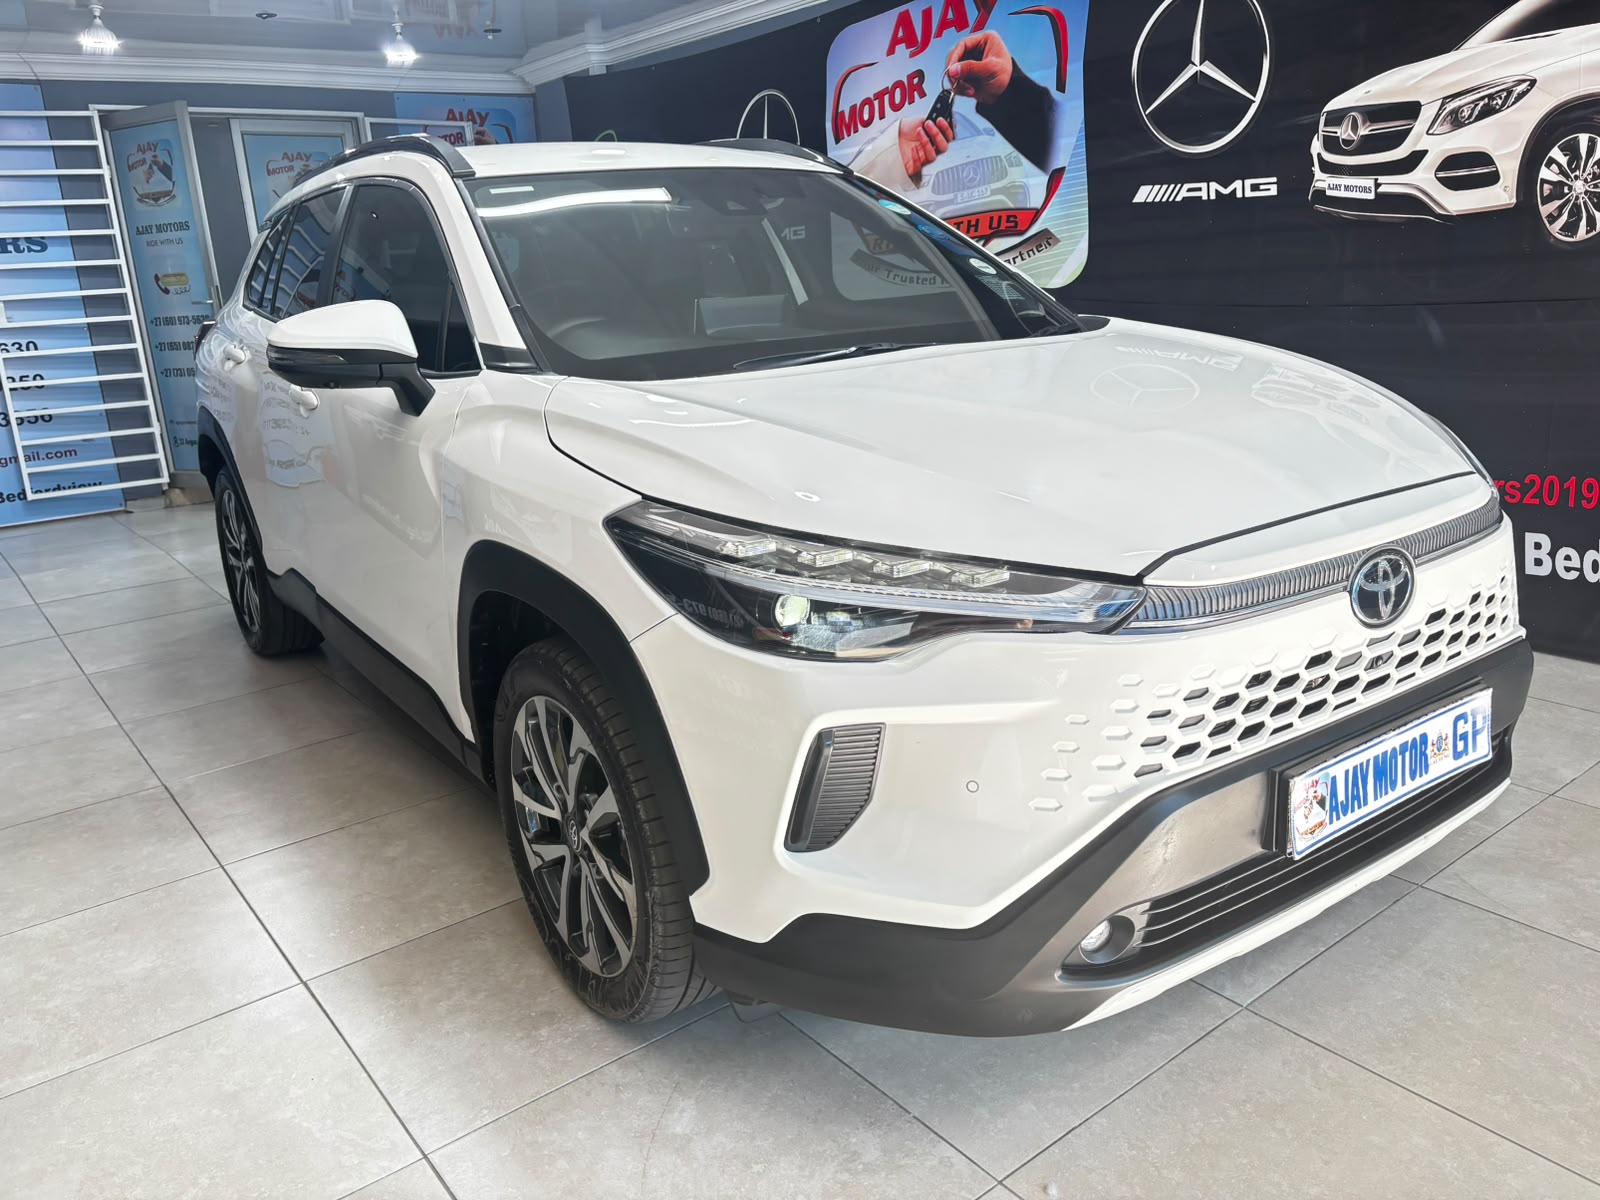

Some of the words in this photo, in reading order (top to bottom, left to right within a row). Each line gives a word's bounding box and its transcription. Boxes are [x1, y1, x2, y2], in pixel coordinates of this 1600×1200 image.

[886, 0, 998, 58] AJAY
[837, 68, 927, 141] MOTOR
[438, 131, 465, 146] TOR
[136, 142, 159, 154] AJAY
[282, 152, 313, 162] AJAY
[268, 165, 295, 176] MOTOR
[1175, 176, 1278, 202] AMG
[1327, 183, 1343, 191] AJAY
[1343, 184, 1373, 194] MOTORS
[136, 223, 154, 235] AJAY
[155, 221, 190, 234] MOTORS
[989, 213, 1019, 232] US
[160, 238, 175, 246] WITH
[175, 237, 184, 245] US
[885, 268, 937, 286] Trusted
[1329, 758, 1371, 825] AJAY
[1373, 732, 1430, 801] MOTOR
